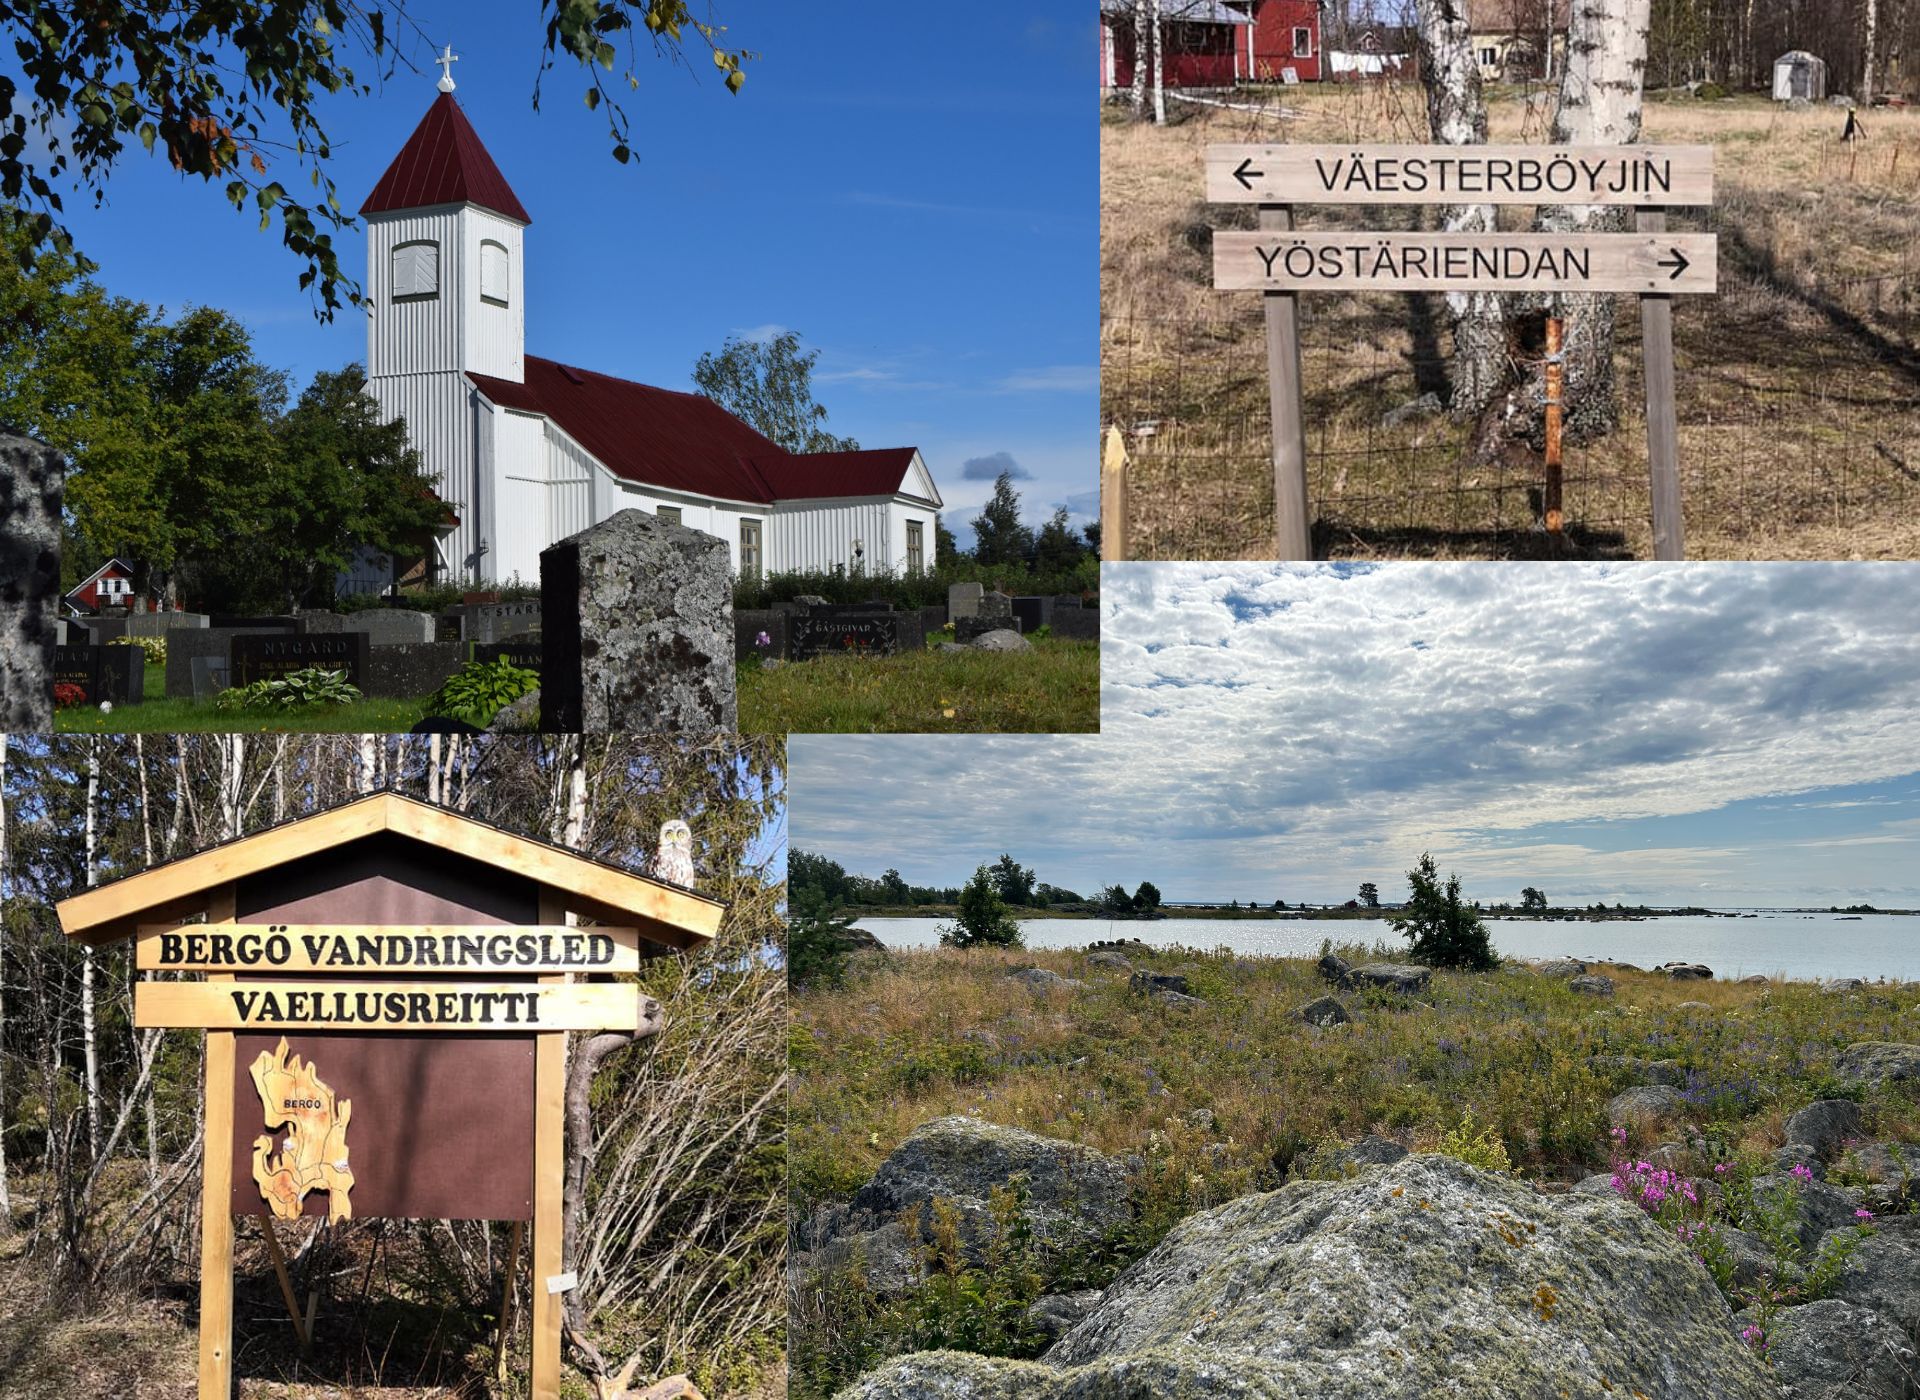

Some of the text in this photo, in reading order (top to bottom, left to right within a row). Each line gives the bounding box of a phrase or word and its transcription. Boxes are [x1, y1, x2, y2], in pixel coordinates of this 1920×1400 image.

[1315, 153, 1671, 193] VÄESTERBÖYJIN
[1256, 241, 1590, 279] YÖSTÄRIENDAN
[160, 926, 615, 966] BERGÖ VANDRINGSLED
[233, 991, 540, 1024] VAELLUSREITTI
